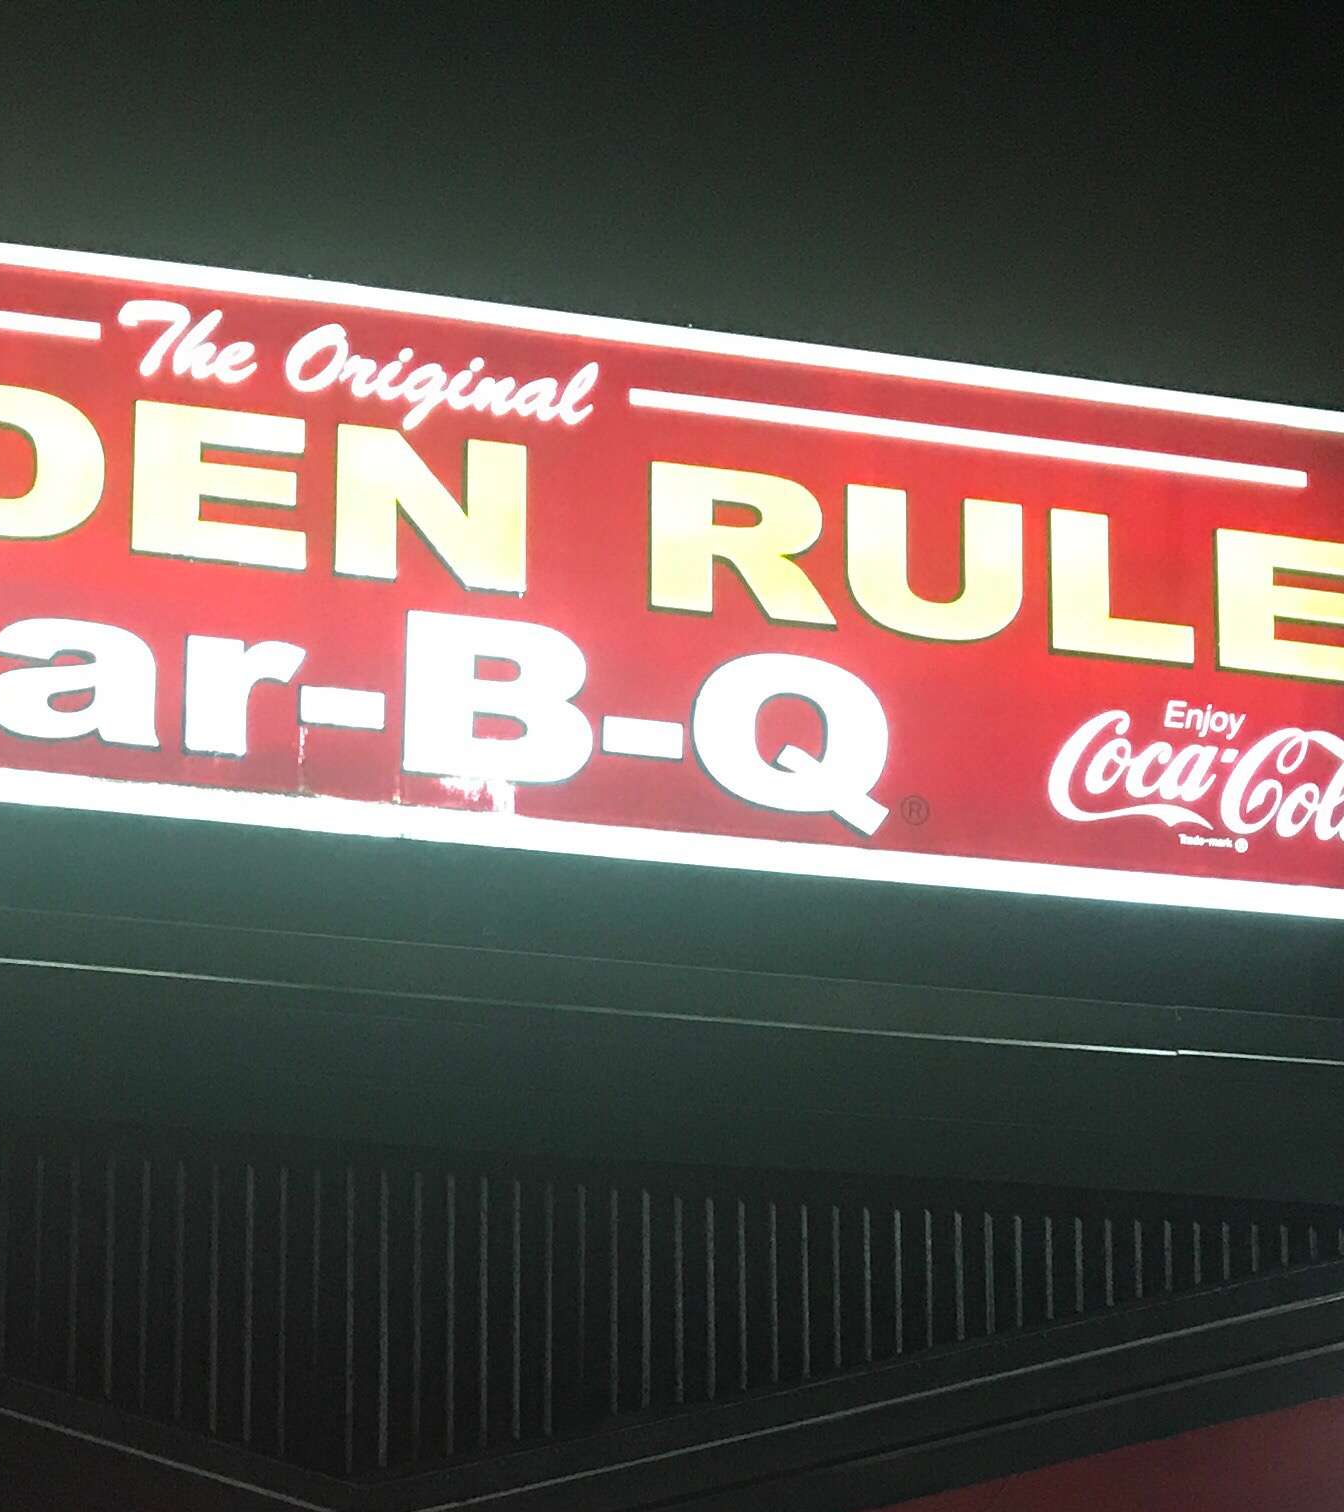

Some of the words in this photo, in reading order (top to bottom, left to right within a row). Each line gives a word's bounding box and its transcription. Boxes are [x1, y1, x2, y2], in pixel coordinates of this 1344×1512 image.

[118, 299, 257, 384] The
[284, 322, 600, 431] Original
[1163, 699, 1247, 740] Enjoy
